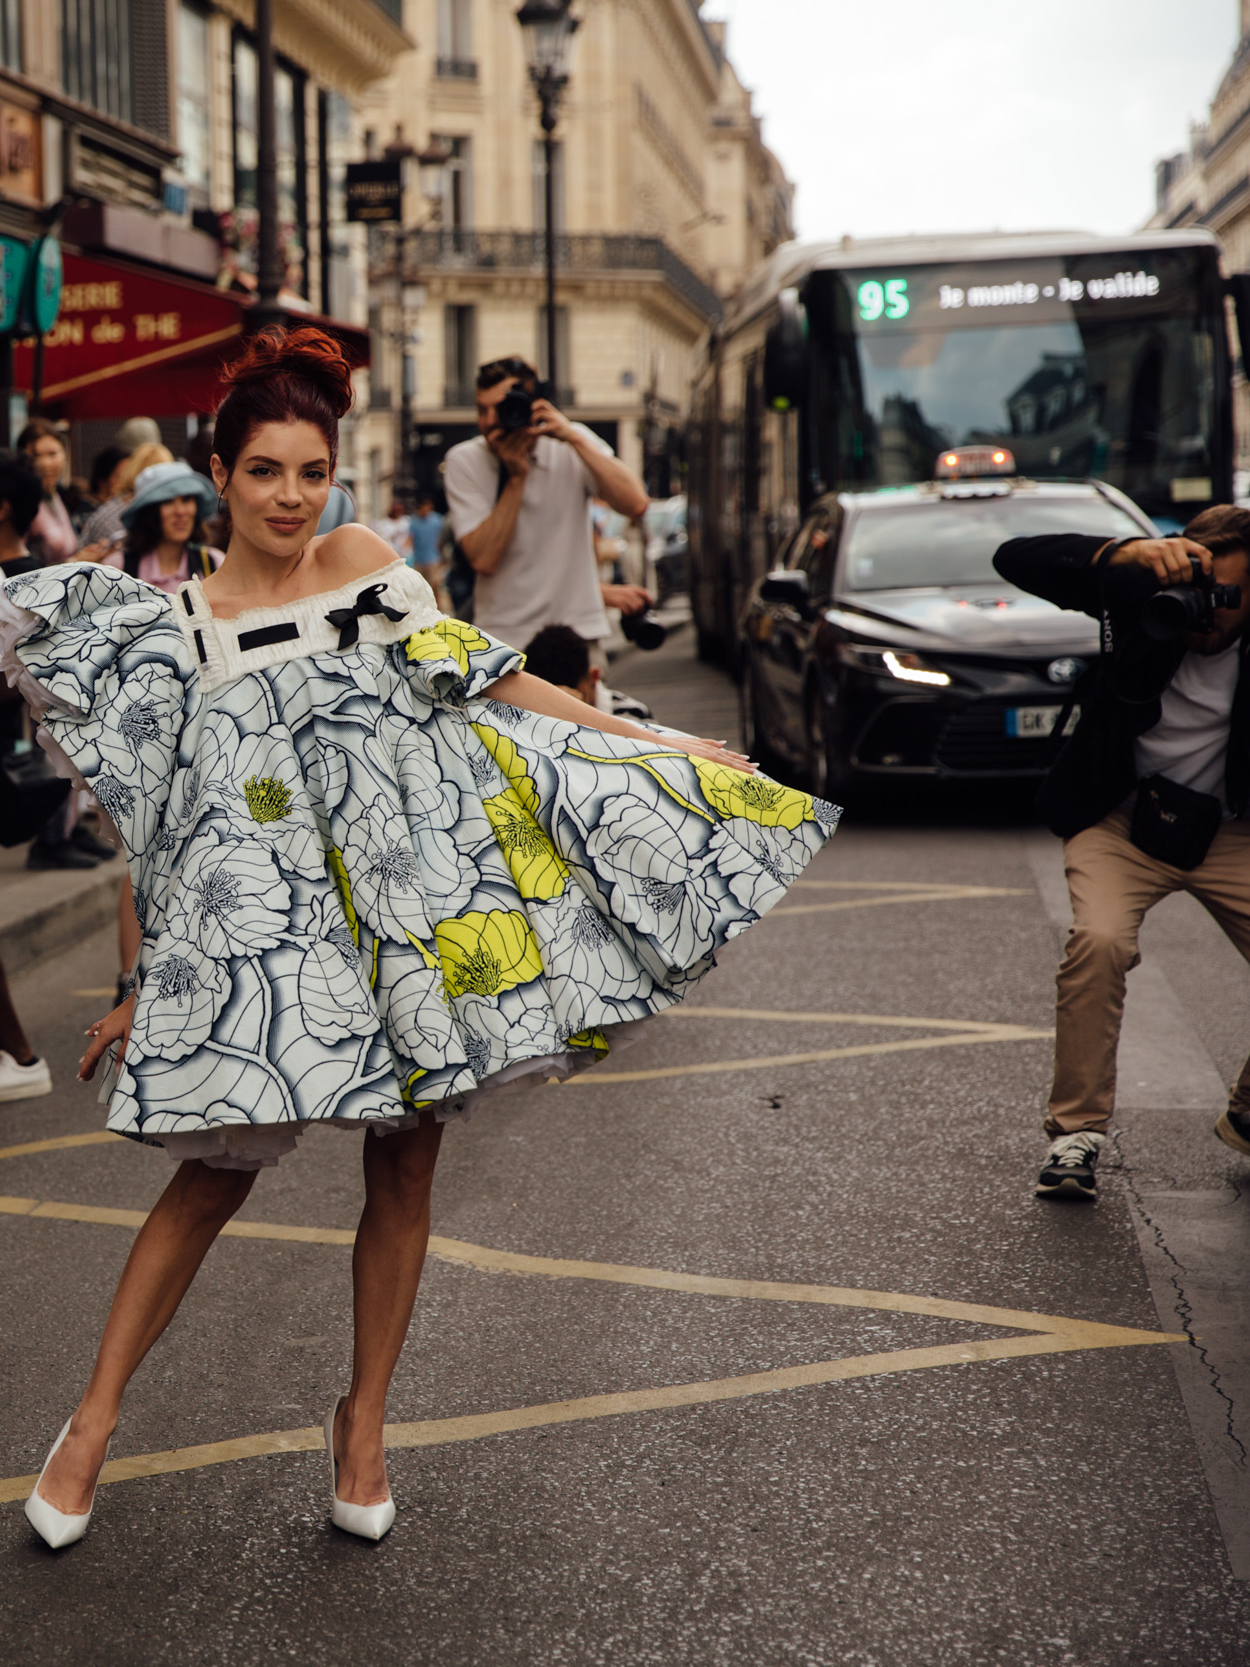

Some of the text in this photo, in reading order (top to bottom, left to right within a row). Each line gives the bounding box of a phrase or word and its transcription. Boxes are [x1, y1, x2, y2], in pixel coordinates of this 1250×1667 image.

[60, 281, 123, 311] SERIE
[857, 278, 910, 321] 95
[968, 280, 1039, 307] monte
[1087, 270, 1160, 300] valide
[91, 314, 126, 344] de
[133, 312, 182, 342] THE
[1103, 608, 1114, 654] SONY
